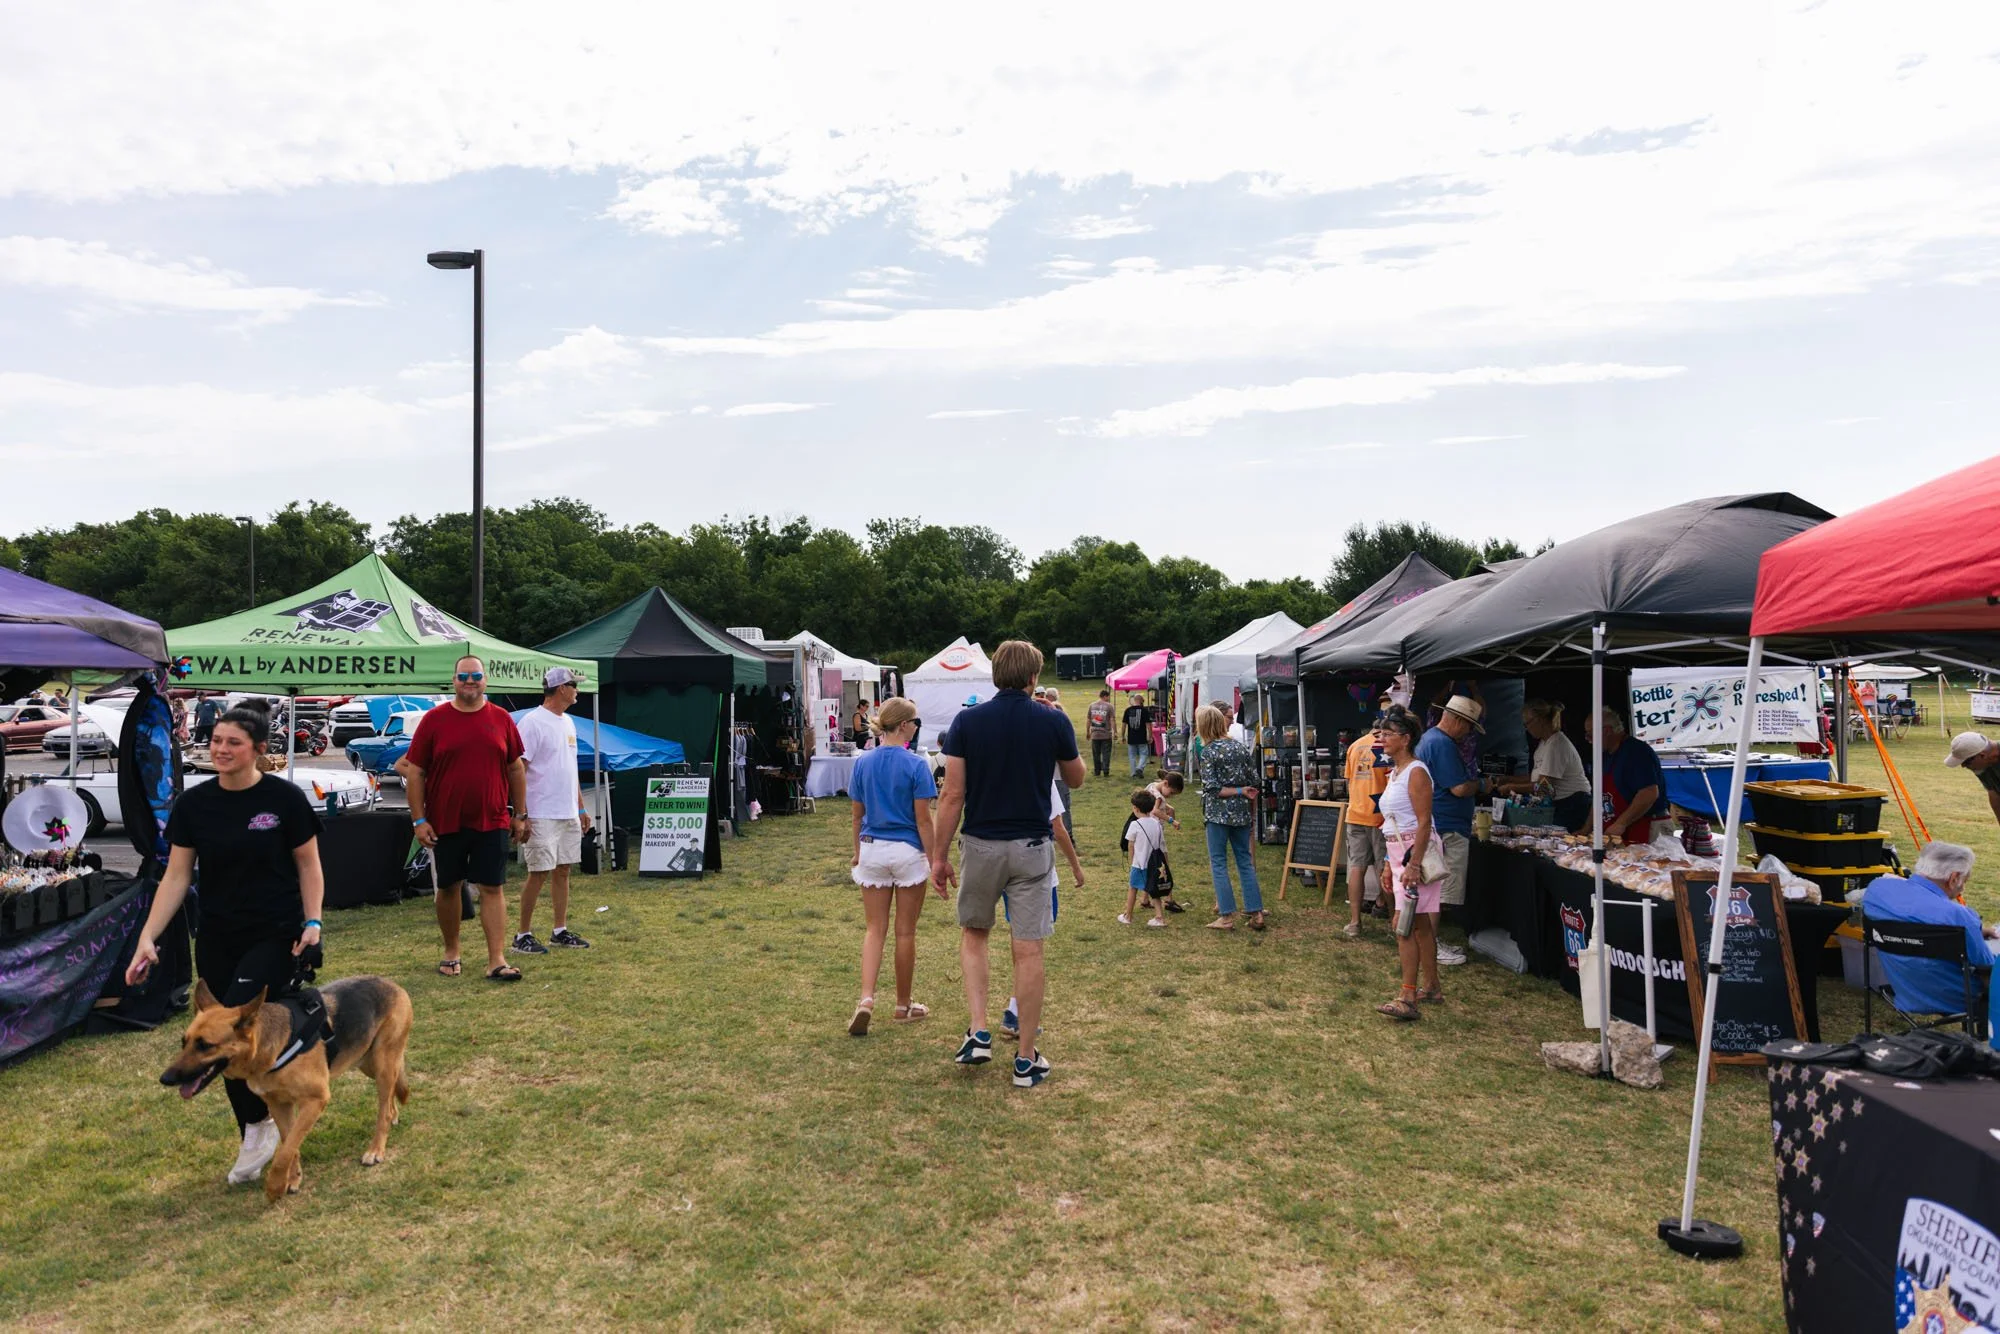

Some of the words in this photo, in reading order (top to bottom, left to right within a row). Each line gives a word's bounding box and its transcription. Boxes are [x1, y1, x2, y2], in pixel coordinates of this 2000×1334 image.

[172, 655, 251, 675] EWAL
[256, 656, 276, 675] by
[280, 655, 416, 675] ANDERSEN
[489, 659, 534, 681] RENEWAL
[1632, 685, 1674, 705] Bottle
[1733, 683, 1806, 704] Rreshed!
[648, 801, 674, 810] ENTER
[675, 801, 686, 809] TO
[686, 801, 705, 809] WIN!
[647, 817, 703, 831] $35,000
[1564, 912, 1580, 929] ROUTE
[1567, 929, 1580, 954] 66
[1723, 929, 1757, 945] urdough
[1609, 947, 1686, 982] URDOUGH
[1916, 1203, 2000, 1275] SHERIF
[1907, 1224, 1957, 1264] OKLAHOMA
[1959, 1259, 2000, 1290] COUN
